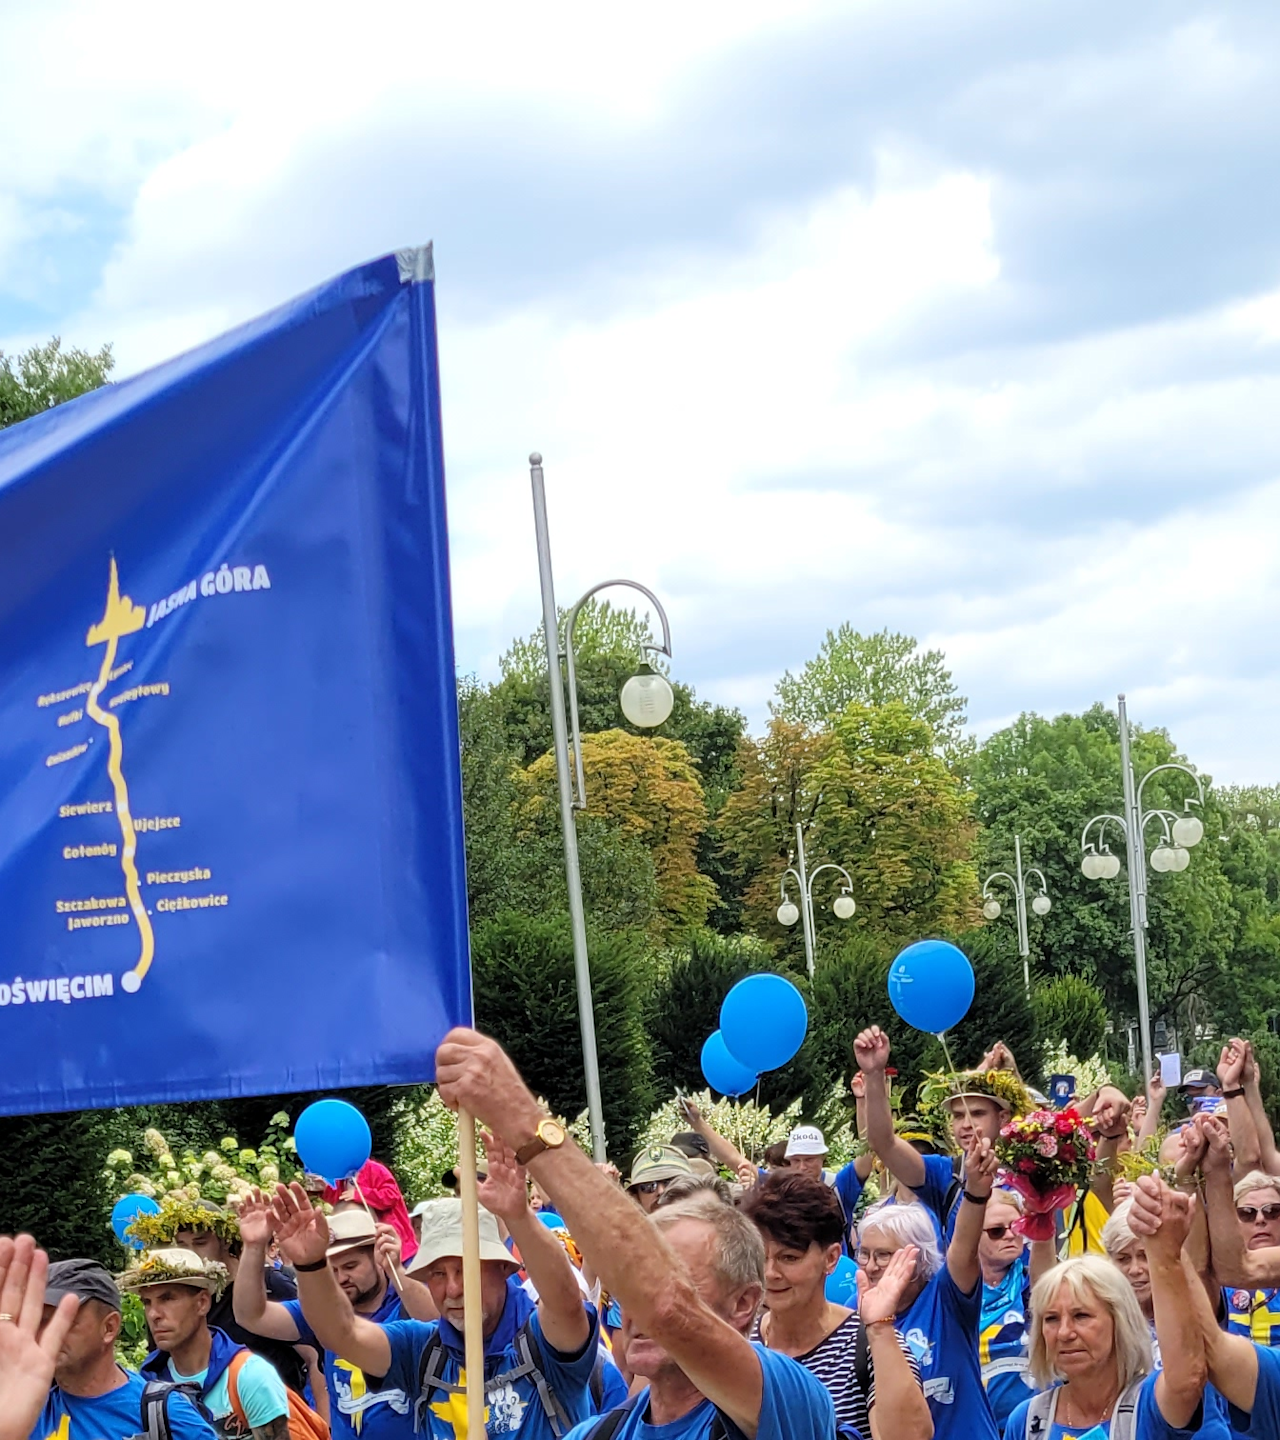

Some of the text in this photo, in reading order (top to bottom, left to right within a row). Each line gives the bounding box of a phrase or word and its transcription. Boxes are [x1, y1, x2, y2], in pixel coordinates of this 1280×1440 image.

[146, 562, 272, 629] JASNA GÓRA
[59, 801, 114, 818] Siewierz
[133, 816, 181, 833] Ujejsce
[146, 866, 212, 885] Pieczyska
[55, 896, 127, 913] Szczakowa
[156, 893, 229, 913] Ciężkowice
[67, 913, 130, 932] Jaworzno
